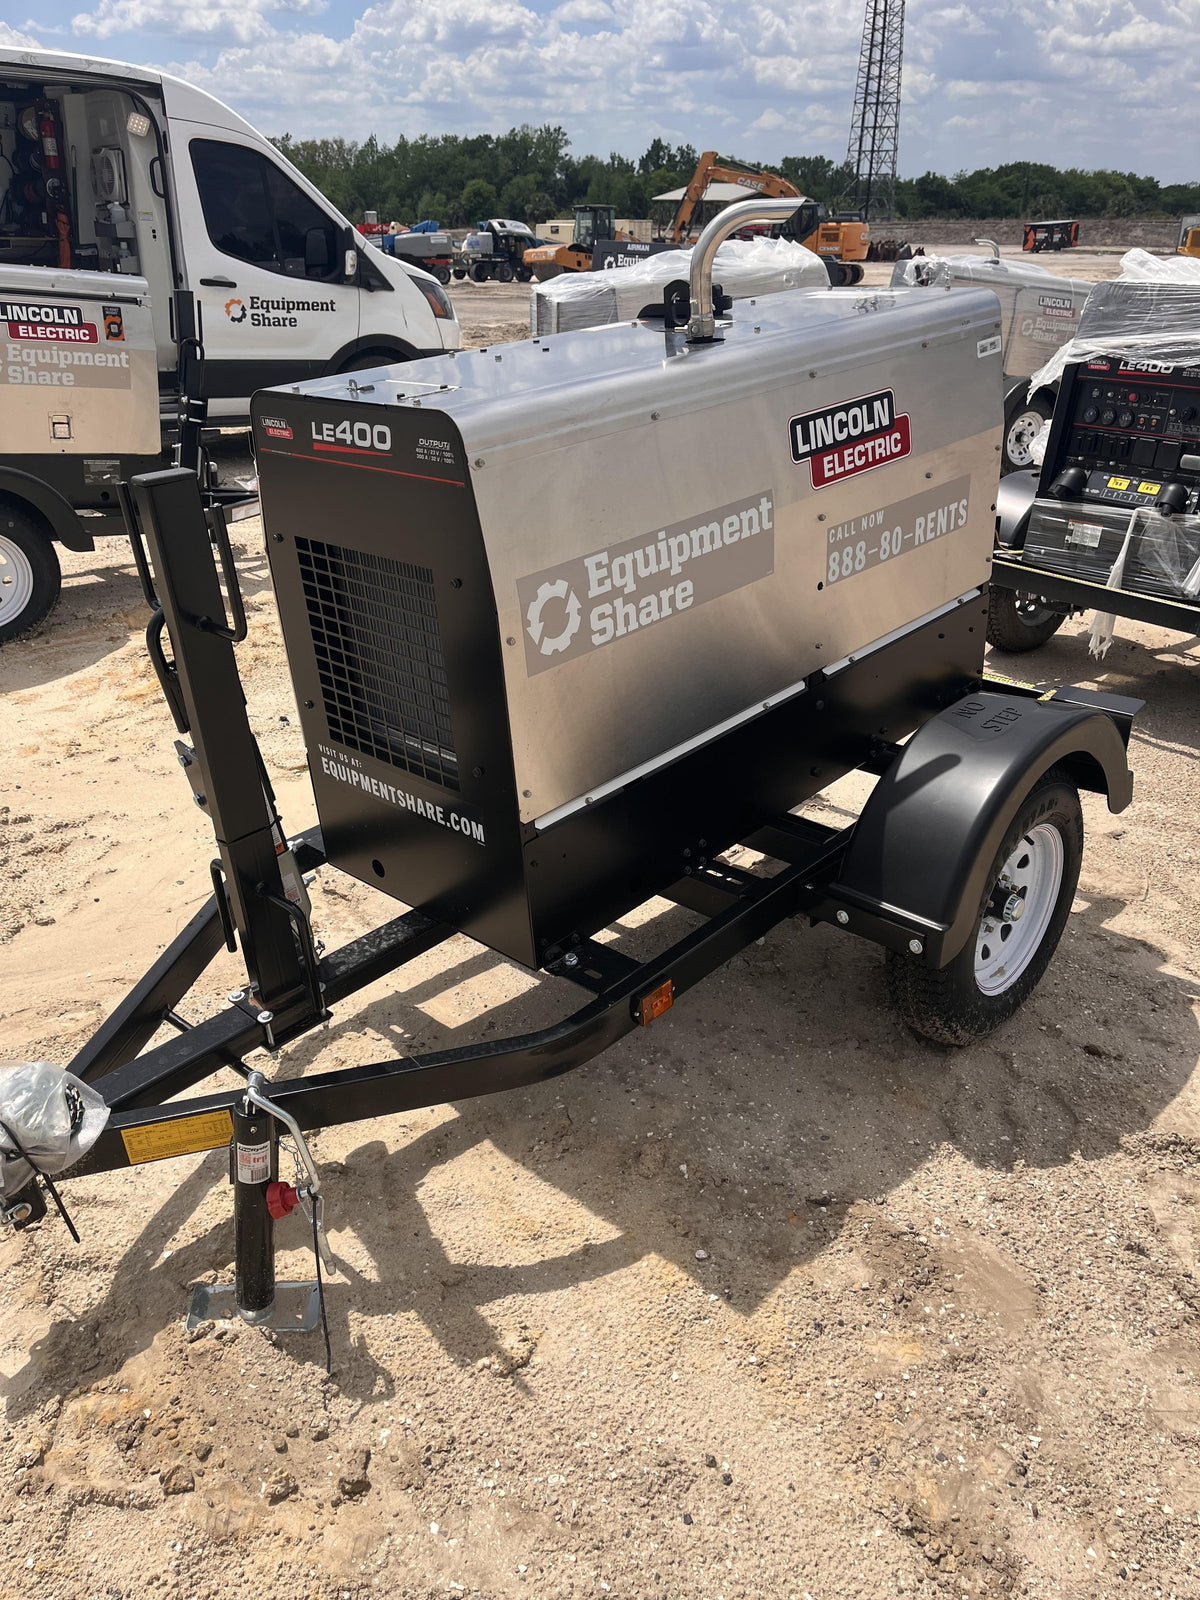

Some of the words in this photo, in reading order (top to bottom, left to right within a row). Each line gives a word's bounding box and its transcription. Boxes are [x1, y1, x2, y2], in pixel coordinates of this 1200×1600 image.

[737, 176, 765, 191] CASE
[249, 296, 336, 314] Equipment
[1040, 296, 1071, 309] LINCOLN
[250, 313, 298, 328] Share
[18, 325, 90, 341] ELECTRIC
[1032, 329, 1058, 342] Share
[6, 343, 130, 369] Equipment
[7, 365, 75, 386] Share
[1119, 360, 1174, 374] LE400
[261, 418, 286, 429] LINCOLN
[268, 428, 291, 438] ELECTRIC
[794, 397, 890, 455] LINCOLN
[311, 420, 392, 451] LE400
[418, 438, 448, 447] OUTPUT
[823, 432, 902, 478] ELECTRIC
[829, 521, 857, 544] CALL
[861, 509, 885, 532] NOW
[584, 496, 773, 599] Equipment
[827, 498, 968, 583] 888-80-RENTS
[590, 579, 694, 646] Share
[951, 702, 986, 719] NO
[980, 707, 1023, 732] STEP
[318, 743, 337, 759] VISIT
[339, 752, 349, 763] US
[351, 757, 362, 768] AT:
[321, 756, 486, 843] EQUIPMENTSHARE.COM
